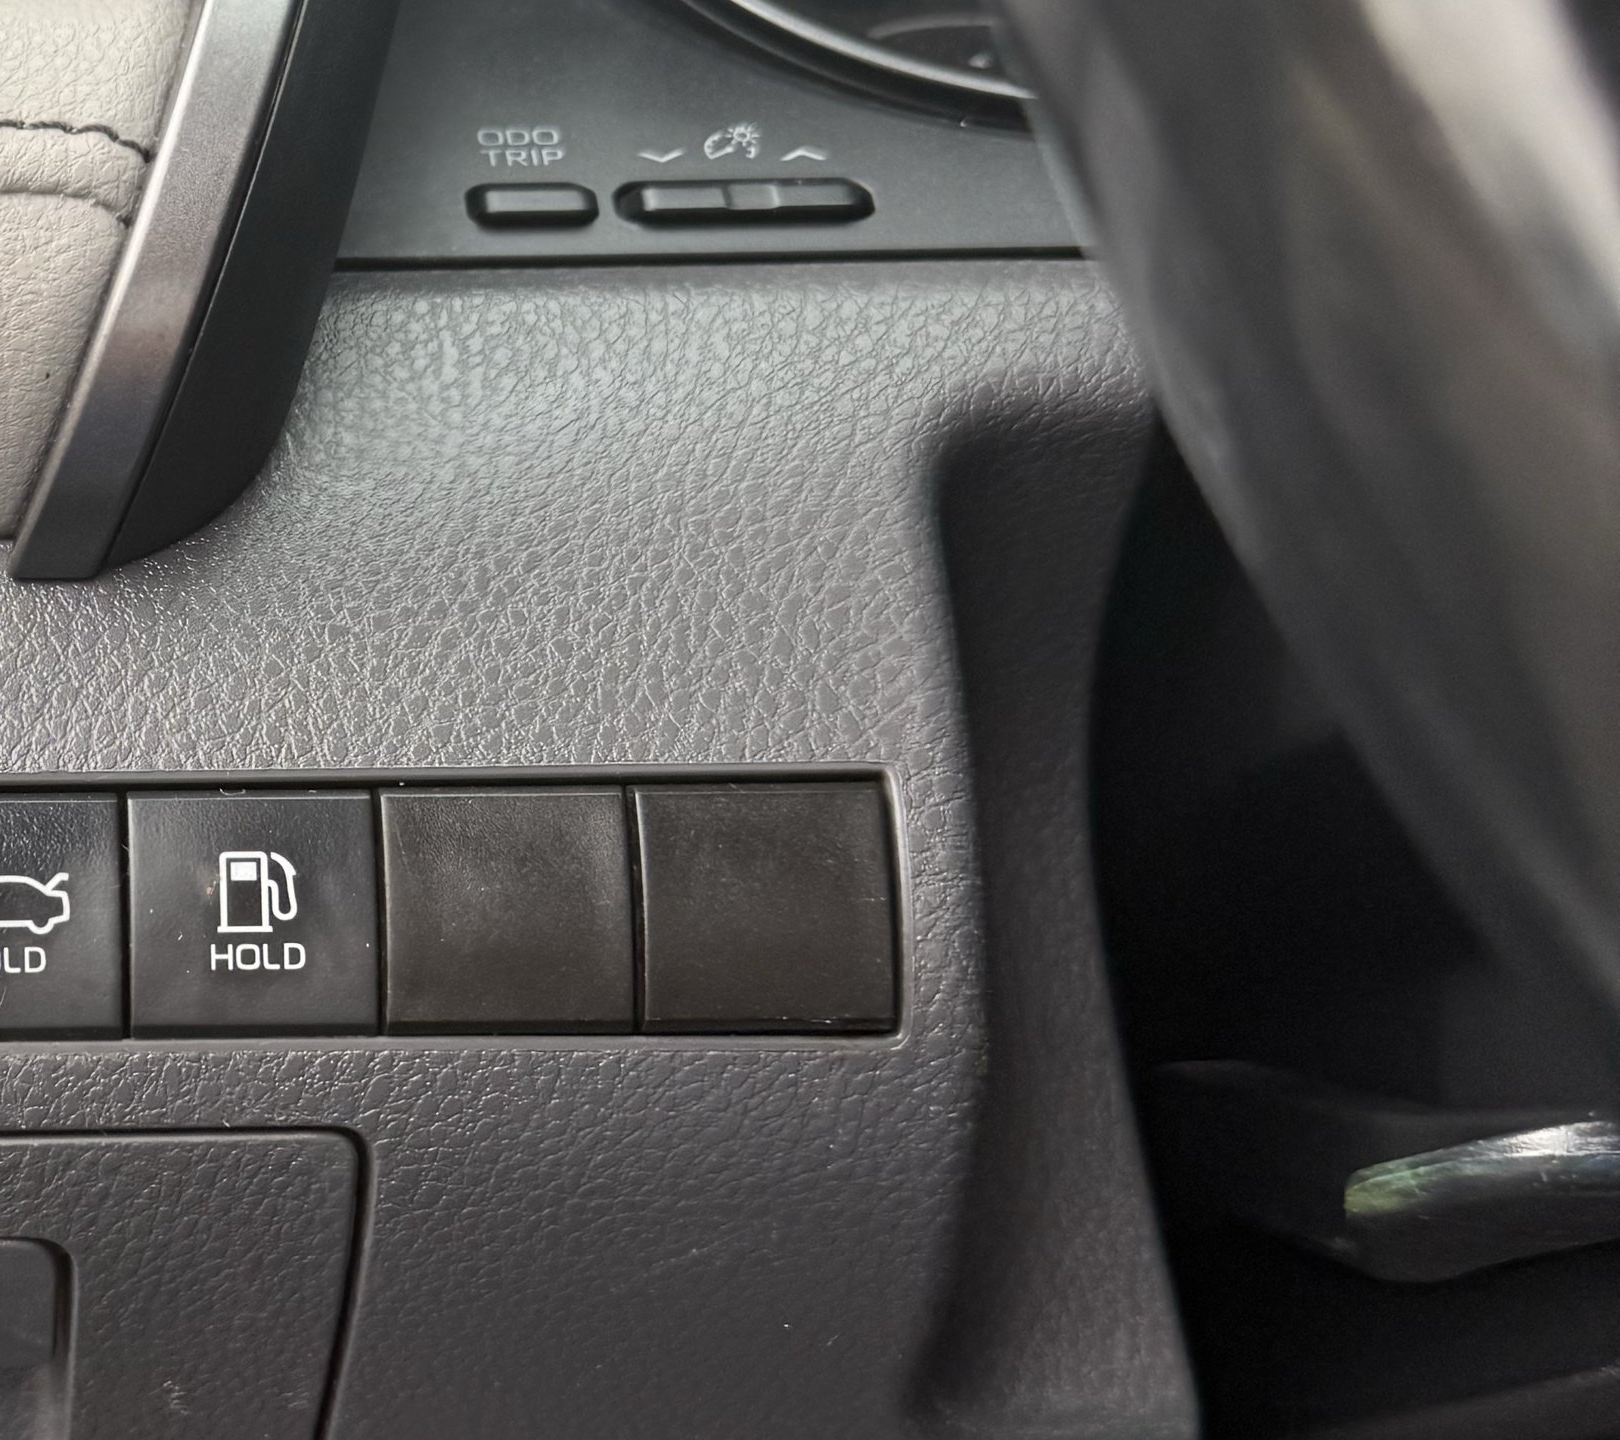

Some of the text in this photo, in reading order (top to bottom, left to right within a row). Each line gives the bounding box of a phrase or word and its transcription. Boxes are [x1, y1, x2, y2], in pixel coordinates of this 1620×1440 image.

[477, 128, 560, 147] ODO
[480, 148, 564, 167] TRIP
[210, 942, 306, 971] HOLD
